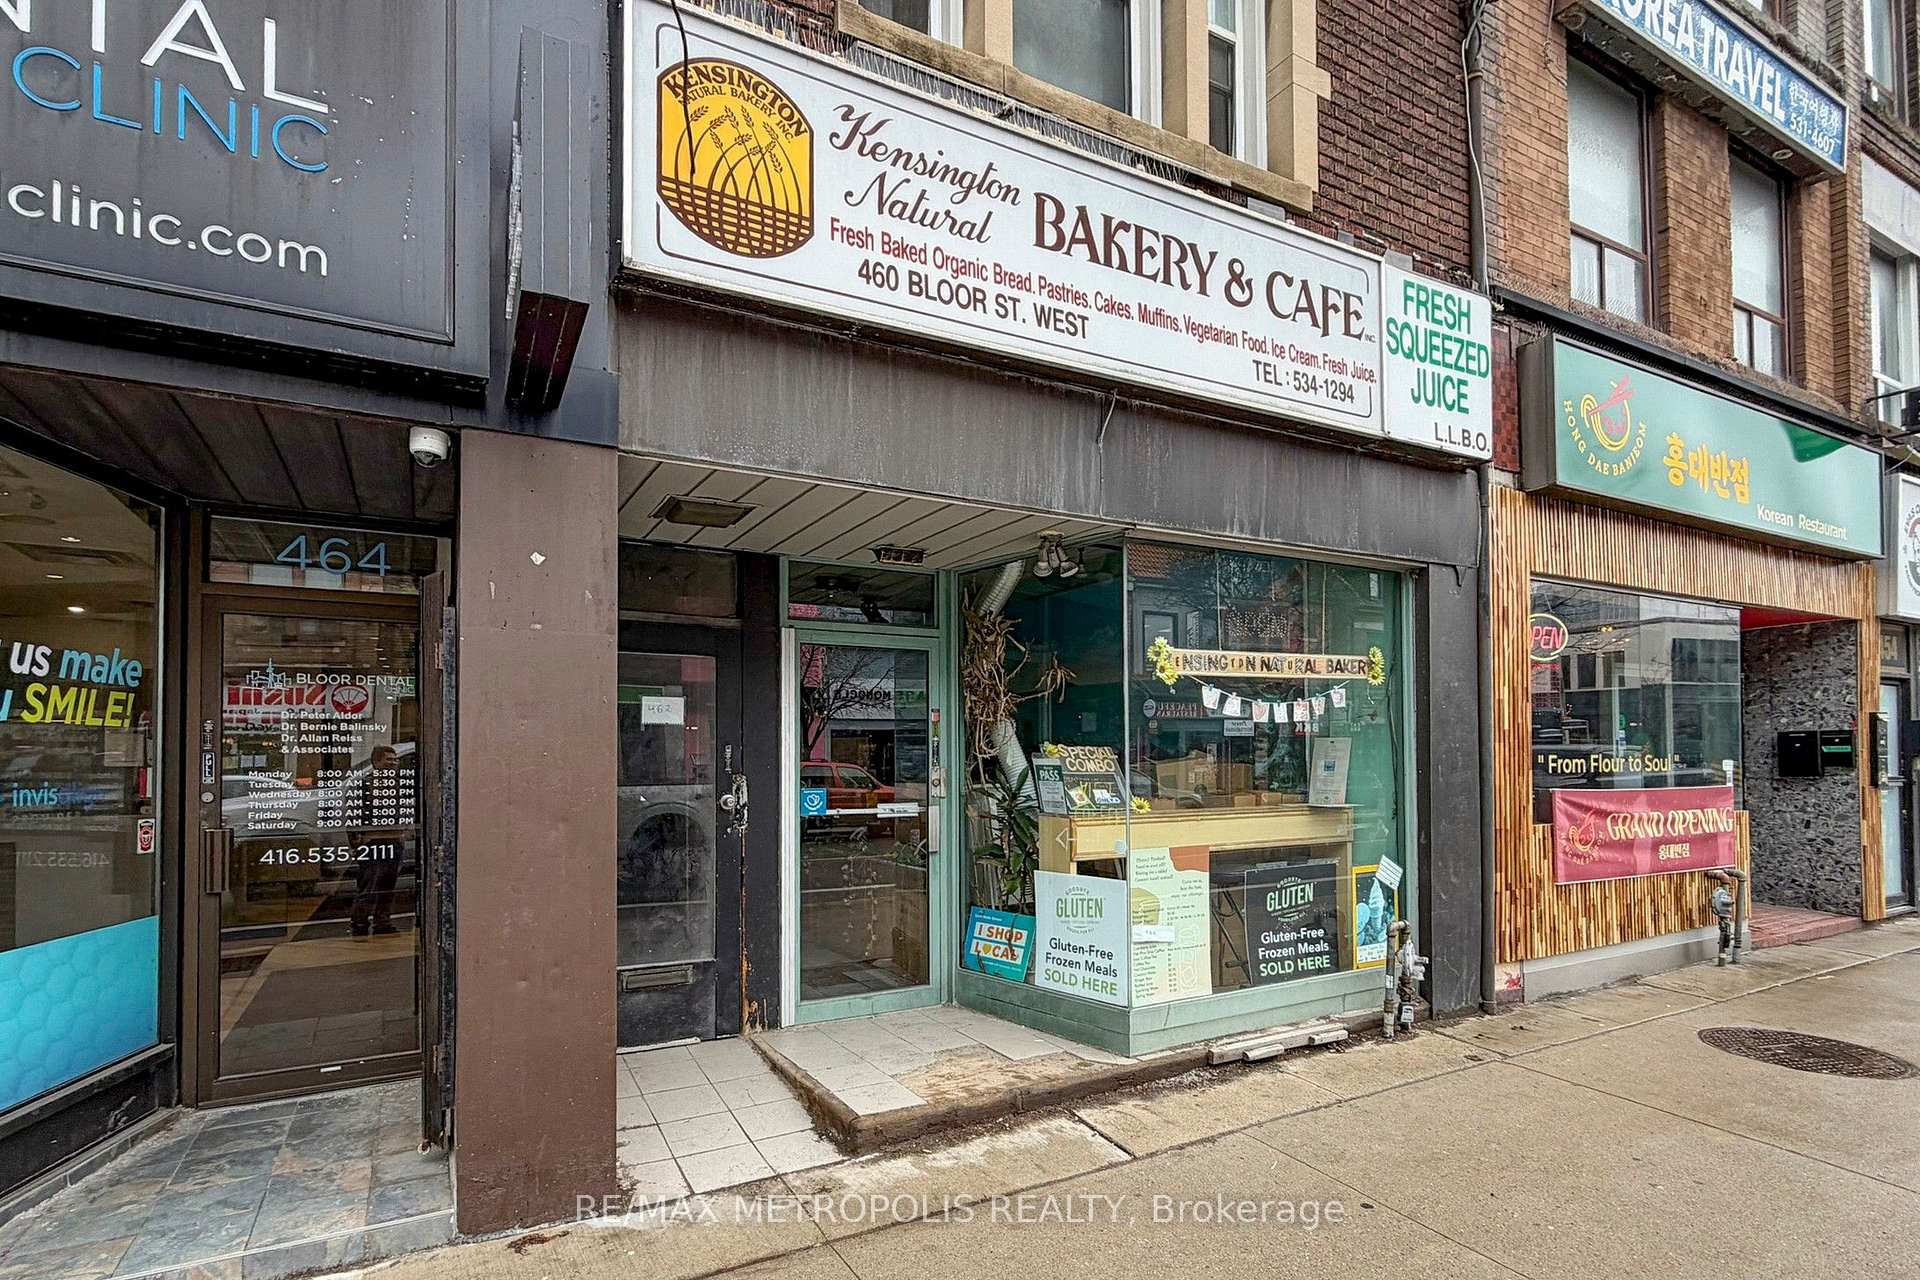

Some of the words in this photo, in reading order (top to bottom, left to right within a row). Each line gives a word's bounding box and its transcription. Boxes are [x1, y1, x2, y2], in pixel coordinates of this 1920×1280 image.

[1611, 0, 1697, 62] OREA
[1700, 15, 1787, 122] TRAVEL
[12, 46, 329, 173] CLINIC
[664, 65, 808, 138] KENSINGTON
[678, 85, 726, 106] NATURAL
[731, 87, 777, 118] BAKERY
[775, 120, 795, 144] INC.
[828, 103, 1022, 207] Kensington
[844, 171, 993, 244] Natural
[8, 180, 328, 277] clinic.com
[1033, 192, 1218, 296] BAKERY
[1224, 257, 1253, 308] &
[1266, 270, 1364, 341] CAFE
[830, 217, 874, 252] Fresh
[881, 228, 928, 265] Baked
[933, 249, 988, 284] Organic
[993, 262, 1036, 296] Bread.
[1038, 275, 1092, 309] Pastries.
[1094, 291, 1134, 320] Cakes.
[1138, 302, 1182, 332] Muffins.
[1184, 314, 1239, 349] Vegetarian
[1241, 331, 1270, 355] Food.
[1271, 341, 1286, 360] Ice
[1323, 354, 1348, 377] Fresh
[1350, 361, 1377, 384] Juice.
[858, 258, 900, 291] 460
[908, 272, 987, 314] BLOOR
[995, 294, 1026, 324] ST.
[1034, 303, 1089, 339] WEST
[1403, 280, 1471, 334] FRESH
[1386, 319, 1489, 378] SQUEEZED
[1293, 374, 1355, 403] 534-1294
[1411, 368, 1470, 414] JUICE
[1434, 423, 1490, 452] L.L.B.O.
[1564, 400, 1586, 453] HONG
[1588, 452, 1609, 475] DAE
[1612, 420, 1647, 476] BANJEOM
[1663, 432, 1750, 504] 홍대반점
[1757, 504, 1794, 528] Korean
[1798, 514, 1847, 541] Restaurant
[276, 535, 391, 577] 464
[1529, 626, 1563, 649] PEN
[10, 642, 52, 677] us
[58, 648, 143, 688] make
[1167, 654, 1256, 672] ENSINGTON
[1260, 655, 1321, 674] NATURAL
[296, 673, 351, 685] BLOOR
[356, 675, 414, 686] DENTAL
[20, 682, 136, 729] SMILE!
[281, 711, 297, 720] Dr.
[300, 711, 331, 720] Peter
[281, 723, 297, 731] Dr.
[300, 723, 338, 731] Bernie
[340, 722, 387, 733] Balinsky
[281, 734, 297, 742] Dr.
[299, 734, 330, 742] Allan
[332, 734, 363, 742] Reiss
[281, 746, 290, 754] &
[292, 745, 355, 754] Associates
[1057, 743, 1118, 760] SPECIAL
[249, 771, 292, 779] Monday
[317, 770, 342, 778] 8:00
[372, 769, 395, 778] 5:30
[400, 769, 415, 777] PM
[1040, 769, 1060, 781] PASS
[1066, 757, 1115, 772] COMBO
[1548, 755, 1586, 773] From
[1590, 754, 1625, 773] Flour
[1628, 756, 1642, 772] to
[1645, 754, 1671, 772] Soul
[248, 790, 312, 799] Wednesday
[317, 789, 342, 797] 8:00
[372, 788, 395, 796] 8:00
[400, 788, 415, 796] PM
[249, 781, 294, 790] Tuesday
[317, 779, 342, 787] 8:00
[248, 801, 298, 809] Thursday
[317, 799, 342, 807] 8:00
[372, 798, 395, 806] 8:00
[400, 798, 415, 806] PM
[248, 811, 283, 819] Friday
[317, 809, 342, 817] 8:00
[372, 808, 395, 816] 5:00
[247, 821, 296, 830] Saturday
[317, 819, 342, 827] 9:00
[372, 818, 395, 826] 3:00
[400, 818, 415, 826] PM
[1606, 811, 1664, 841] GRAND
[1666, 806, 1734, 837] OPENING
[260, 845, 395, 865] 416.535.2111
[1658, 843, 1690, 860] 홍대반점
[1056, 897, 1103, 918] GLUTEN
[1266, 882, 1314, 912] GLUTEN
[978, 924, 984, 936] I
[986, 926, 1023, 943] SHOP
[1260, 927, 1325, 944] Gluten-Free
[1049, 937, 1114, 961] Gluten-Free
[1258, 943, 1295, 960] Frozen
[1297, 940, 1329, 954] Meals
[1045, 952, 1081, 970] Frozen
[1084, 959, 1118, 978] Meals
[1258, 961, 1295, 977] SOLD
[1297, 956, 1331, 971] HERE
[1044, 968, 1079, 987] SOLD
[1082, 976, 1118, 996] HERE
